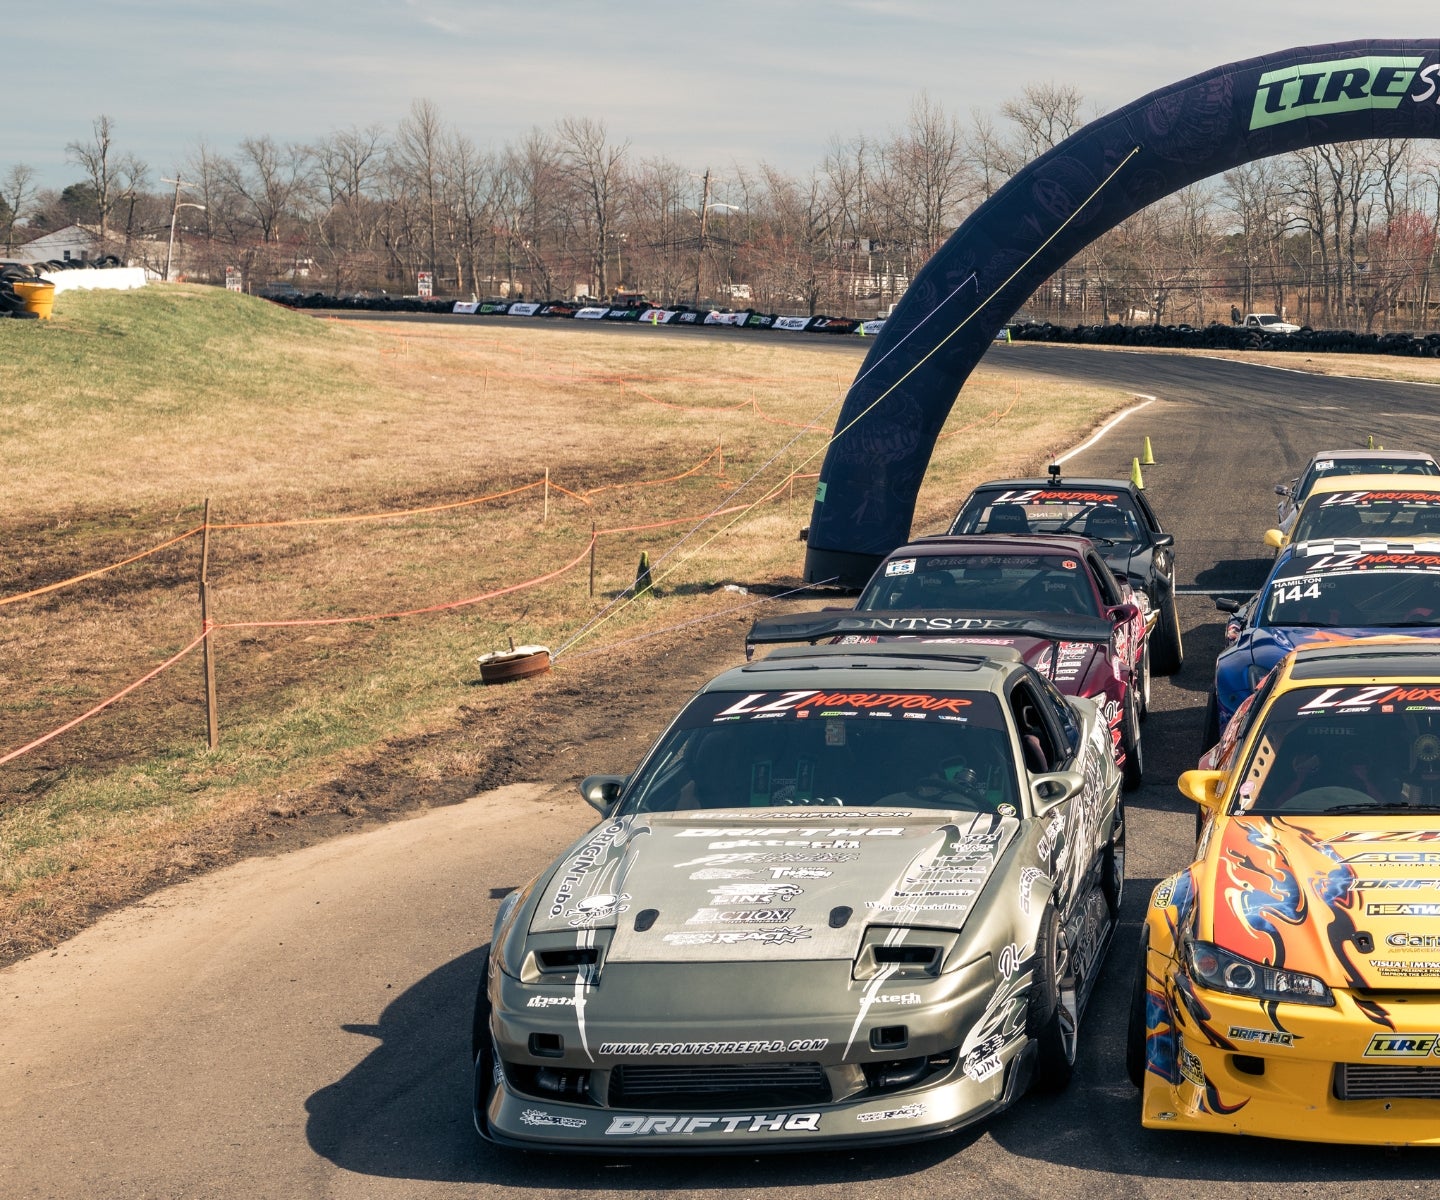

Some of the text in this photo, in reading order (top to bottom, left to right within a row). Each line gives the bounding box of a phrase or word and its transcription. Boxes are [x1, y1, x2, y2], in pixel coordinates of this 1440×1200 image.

[1256, 66, 1418, 115] TIRE
[993, 490, 1119, 503] LZ WORLDTOUR
[1320, 492, 1370, 507] LZ
[1308, 553, 1367, 570] LZ
[1274, 577, 1322, 589] HAMILTON
[1273, 583, 1322, 604] 144
[716, 690, 973, 716] LZ WORLDTOUR
[1298, 685, 1400, 710] LZ
[674, 827, 905, 838] DRIFTHQ
[570, 822, 623, 874] ORIGIN
[714, 931, 787, 945] REACT
[1369, 959, 1408, 968] VISUAL
[1229, 1027, 1294, 1046] DRIFTHQ
[599, 1038, 829, 1055] WWW.FRONTSTREET-D.COM
[1372, 1039, 1432, 1052] TIRE
[604, 1112, 822, 1135] DRIFTHQ
